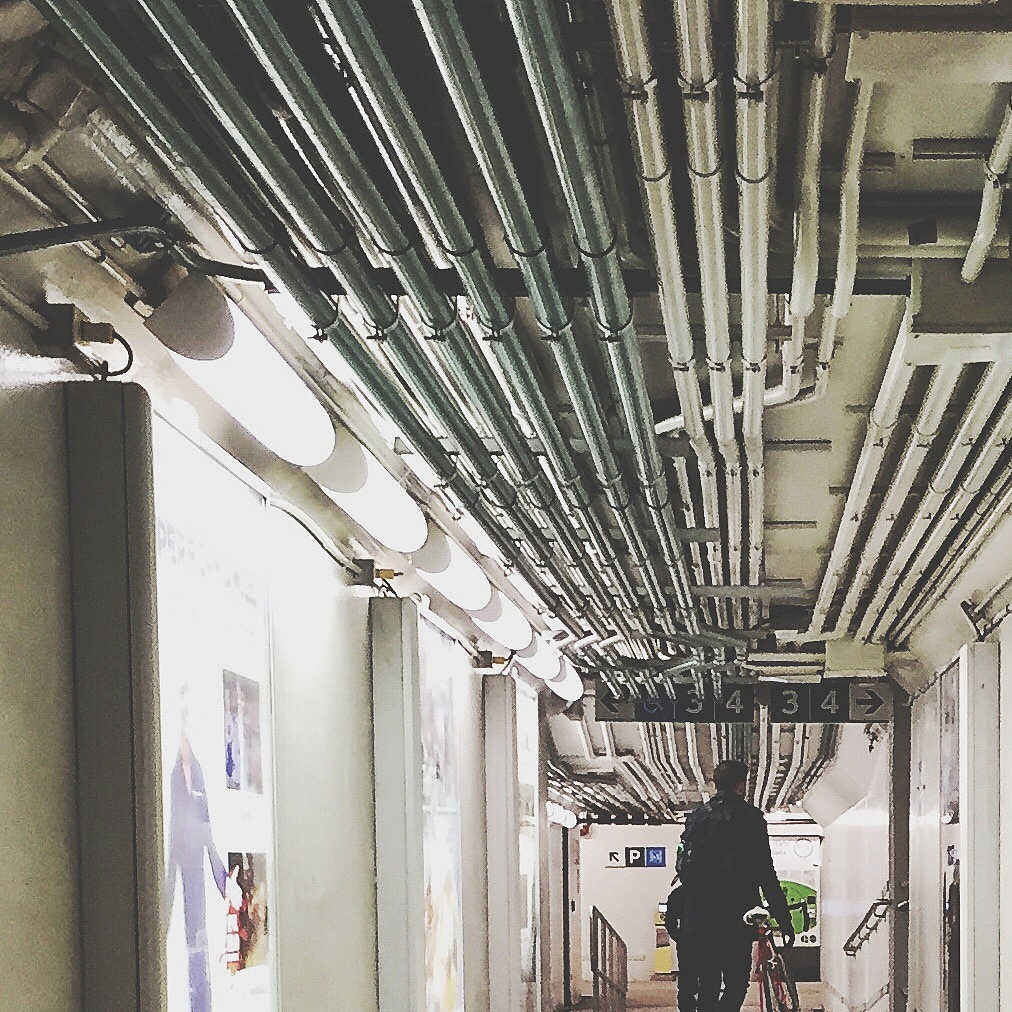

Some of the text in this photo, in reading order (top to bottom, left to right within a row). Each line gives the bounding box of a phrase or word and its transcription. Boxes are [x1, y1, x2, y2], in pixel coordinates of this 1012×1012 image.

[685, 689, 744, 715] 3 4
[781, 690, 840, 714] 3 4
[629, 849, 641, 864] P
